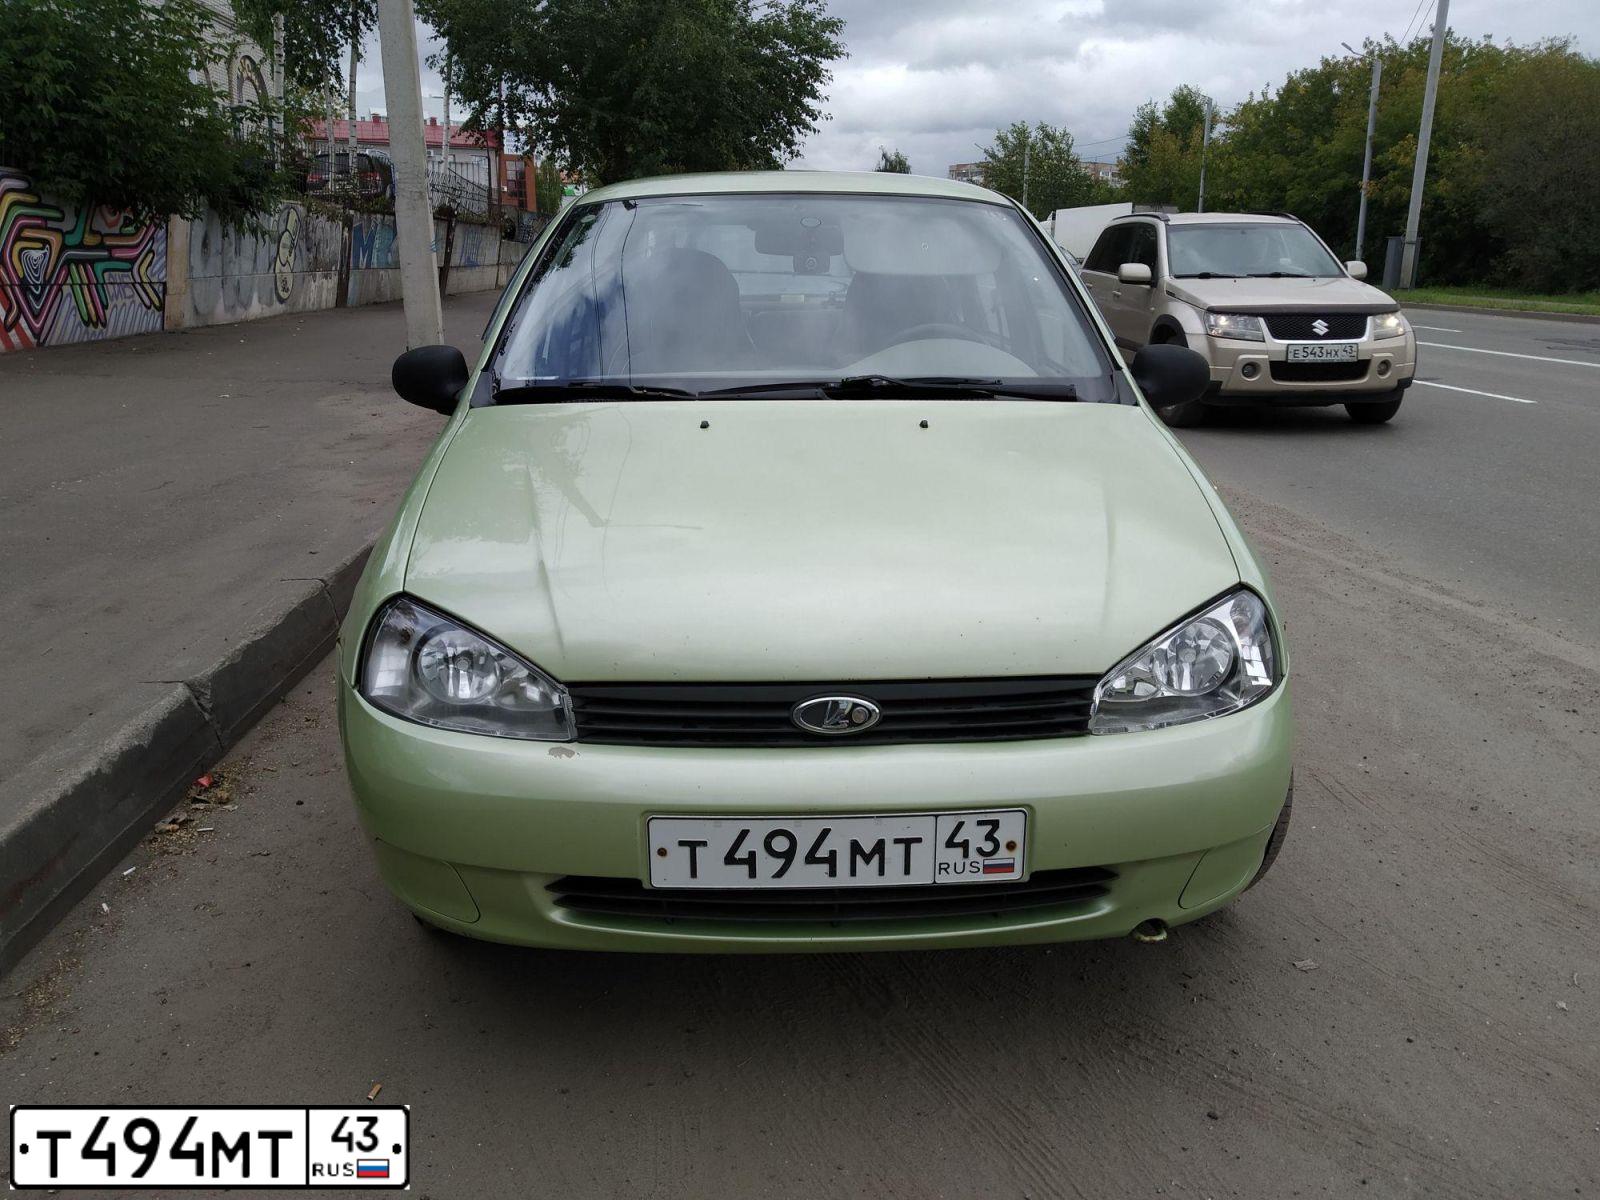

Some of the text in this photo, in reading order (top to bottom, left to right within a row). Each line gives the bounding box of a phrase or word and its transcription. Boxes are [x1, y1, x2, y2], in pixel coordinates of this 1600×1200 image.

[1342, 345, 1354, 355] 43
[677, 818, 1001, 880] Т494МТ 43
[938, 860, 981, 876] RUS
